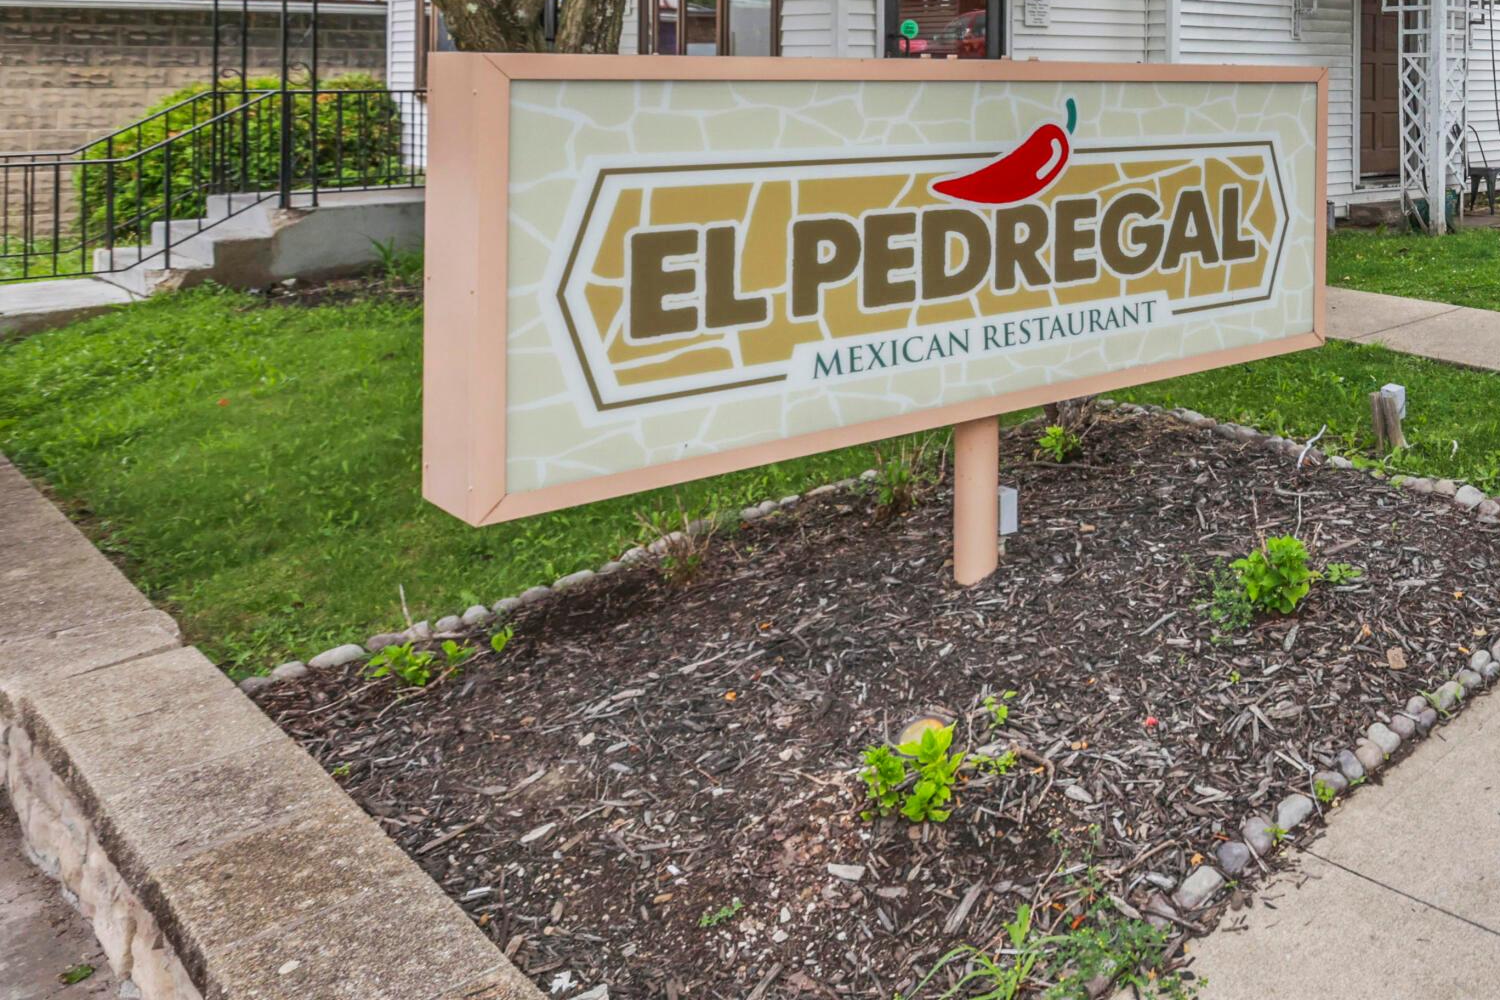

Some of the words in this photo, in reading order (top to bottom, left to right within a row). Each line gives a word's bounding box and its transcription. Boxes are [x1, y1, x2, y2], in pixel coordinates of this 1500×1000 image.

[629, 226, 768, 339] EL
[792, 186, 1257, 318] PEDREGAL
[812, 328, 970, 380] MEXICAN
[983, 300, 1158, 351] RESTAURANT
